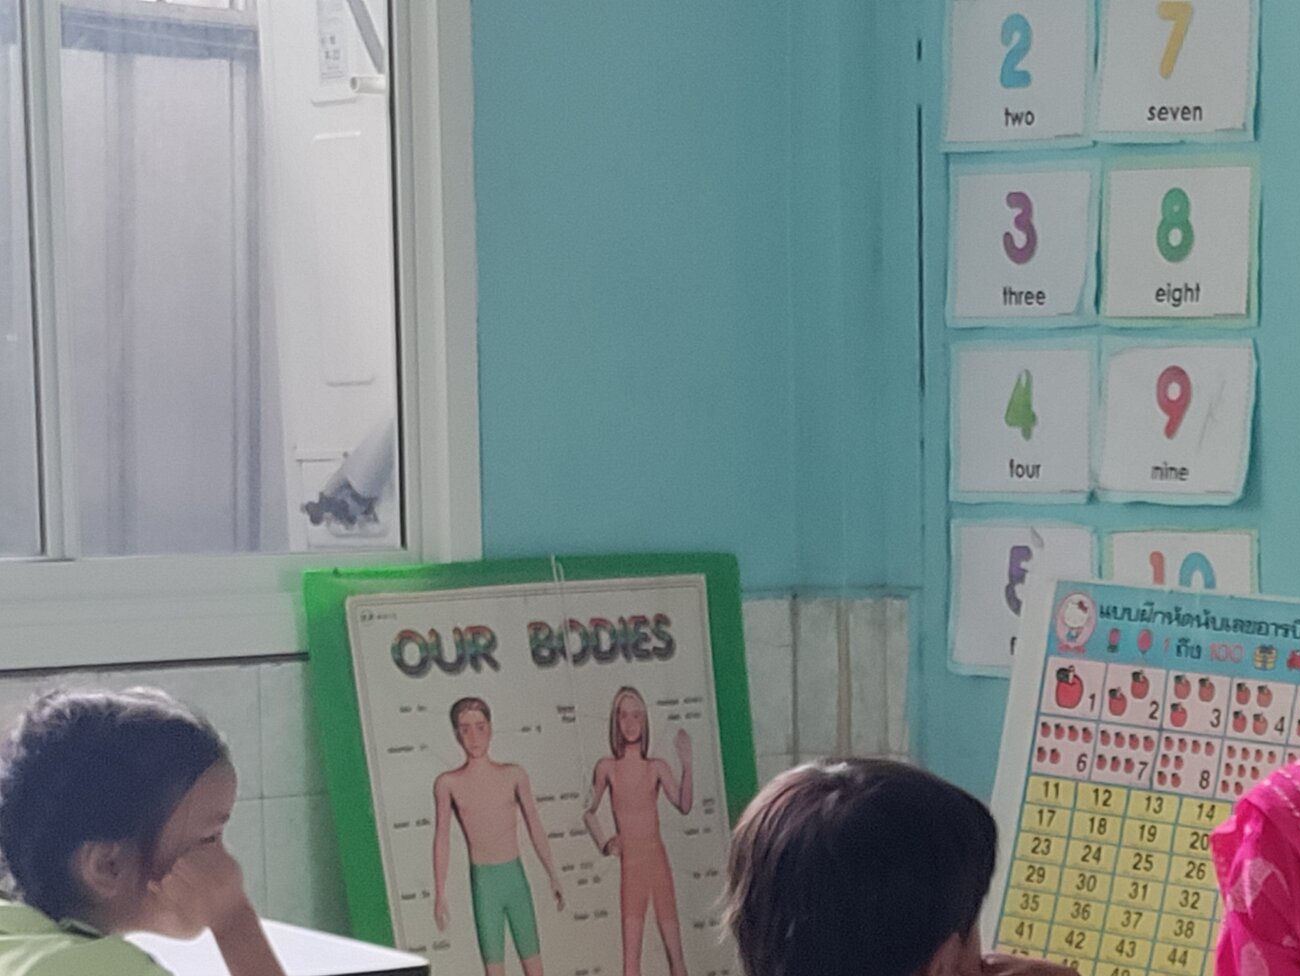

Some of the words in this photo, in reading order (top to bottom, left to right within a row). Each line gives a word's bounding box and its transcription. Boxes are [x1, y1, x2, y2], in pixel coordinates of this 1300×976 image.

[1000, 13, 1032, 88] 2
[1157, 1, 1193, 79] 7
[1004, 107, 1035, 127] two
[1147, 103, 1203, 122] seven
[1003, 191, 1037, 264] 3
[1156, 187, 1195, 263] 8
[1003, 286, 1046, 306] three
[1155, 282, 1201, 307] eight
[1005, 369, 1037, 441] 4
[1156, 365, 1192, 440] 9
[1009, 459, 1041, 480] four
[1151, 462, 1189, 482] nine
[391, 625, 500, 678] OUR
[527, 613, 676, 668] BODIES
[1089, 693, 1096, 712] 1
[1148, 701, 1160, 720] 2
[1210, 709, 1222, 728] 3
[1274, 716, 1285, 736] 4
[1077, 753, 1087, 772] 6
[1137, 762, 1149, 780] 7
[1199, 770, 1210, 789] 8
[1042, 781, 1060, 799] 11
[1092, 788, 1112, 807] 12
[1145, 796, 1163, 814] 13
[1197, 803, 1216, 822] 14
[1037, 809, 1056, 827] 17
[1089, 817, 1107, 835] 18
[1138, 824, 1157, 842] 19
[1189, 832, 1209, 851] 20
[1031, 837, 1051, 856] 23
[1080, 844, 1101, 864] 24
[1132, 852, 1154, 872] 25
[1185, 861, 1206, 880] 26
[1025, 864, 1046, 884] 29
[1076, 873, 1097, 892] 30
[1128, 882, 1148, 901] 31
[1179, 889, 1200, 910] 32
[1020, 893, 1040, 912] 35
[1071, 901, 1091, 921] 36
[1121, 910, 1143, 930] 37
[1173, 919, 1195, 939] 38
[1015, 921, 1034, 940] 41
[1065, 929, 1085, 950] 42
[1115, 939, 1137, 959] 43
[1167, 948, 1188, 967] 44
